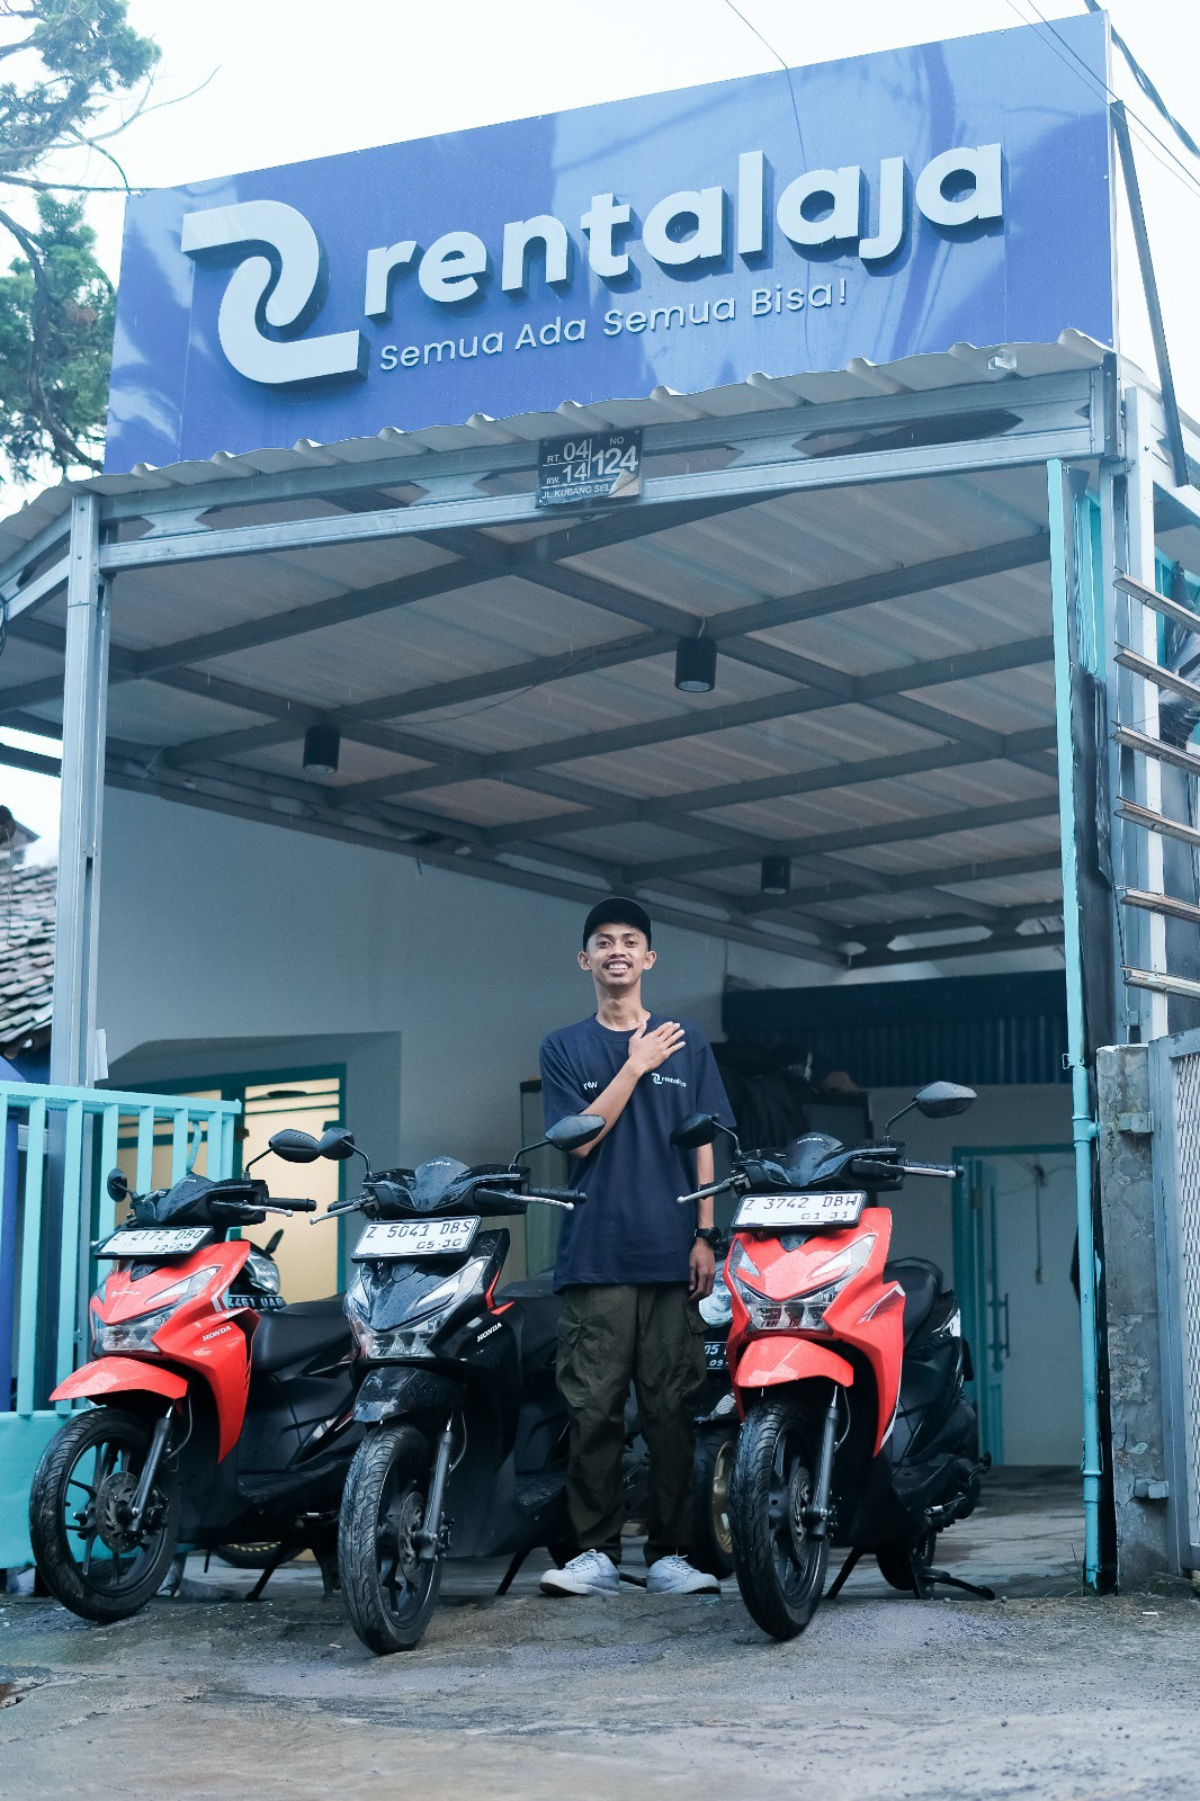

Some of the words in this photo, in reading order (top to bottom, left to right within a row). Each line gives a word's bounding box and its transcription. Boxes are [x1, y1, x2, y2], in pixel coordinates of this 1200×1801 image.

[364, 143, 1002, 316] rentalaja
[379, 331, 504, 371] Semua
[514, 316, 587, 350] Ada
[603, 297, 736, 336] Semua
[751, 277, 847, 316] Bisa!
[563, 440, 589, 461] 04
[609, 436, 625, 446] NO
[591, 445, 639, 475] 124
[562, 462, 588, 483] 14
[554, 484, 592, 497] KUBANG
[744, 1199, 755, 1210] Z
[763, 1197, 810, 1210] 3742
[112, 1232, 127, 1241] Z
[131, 1230, 171, 1241] 4172
[365, 1226, 379, 1239] Z
[387, 1224, 431, 1238] 5041
[439, 1220, 472, 1235] DBS
[202, 1325, 232, 1341] HONDA
[476, 1321, 502, 1342] HONDA
